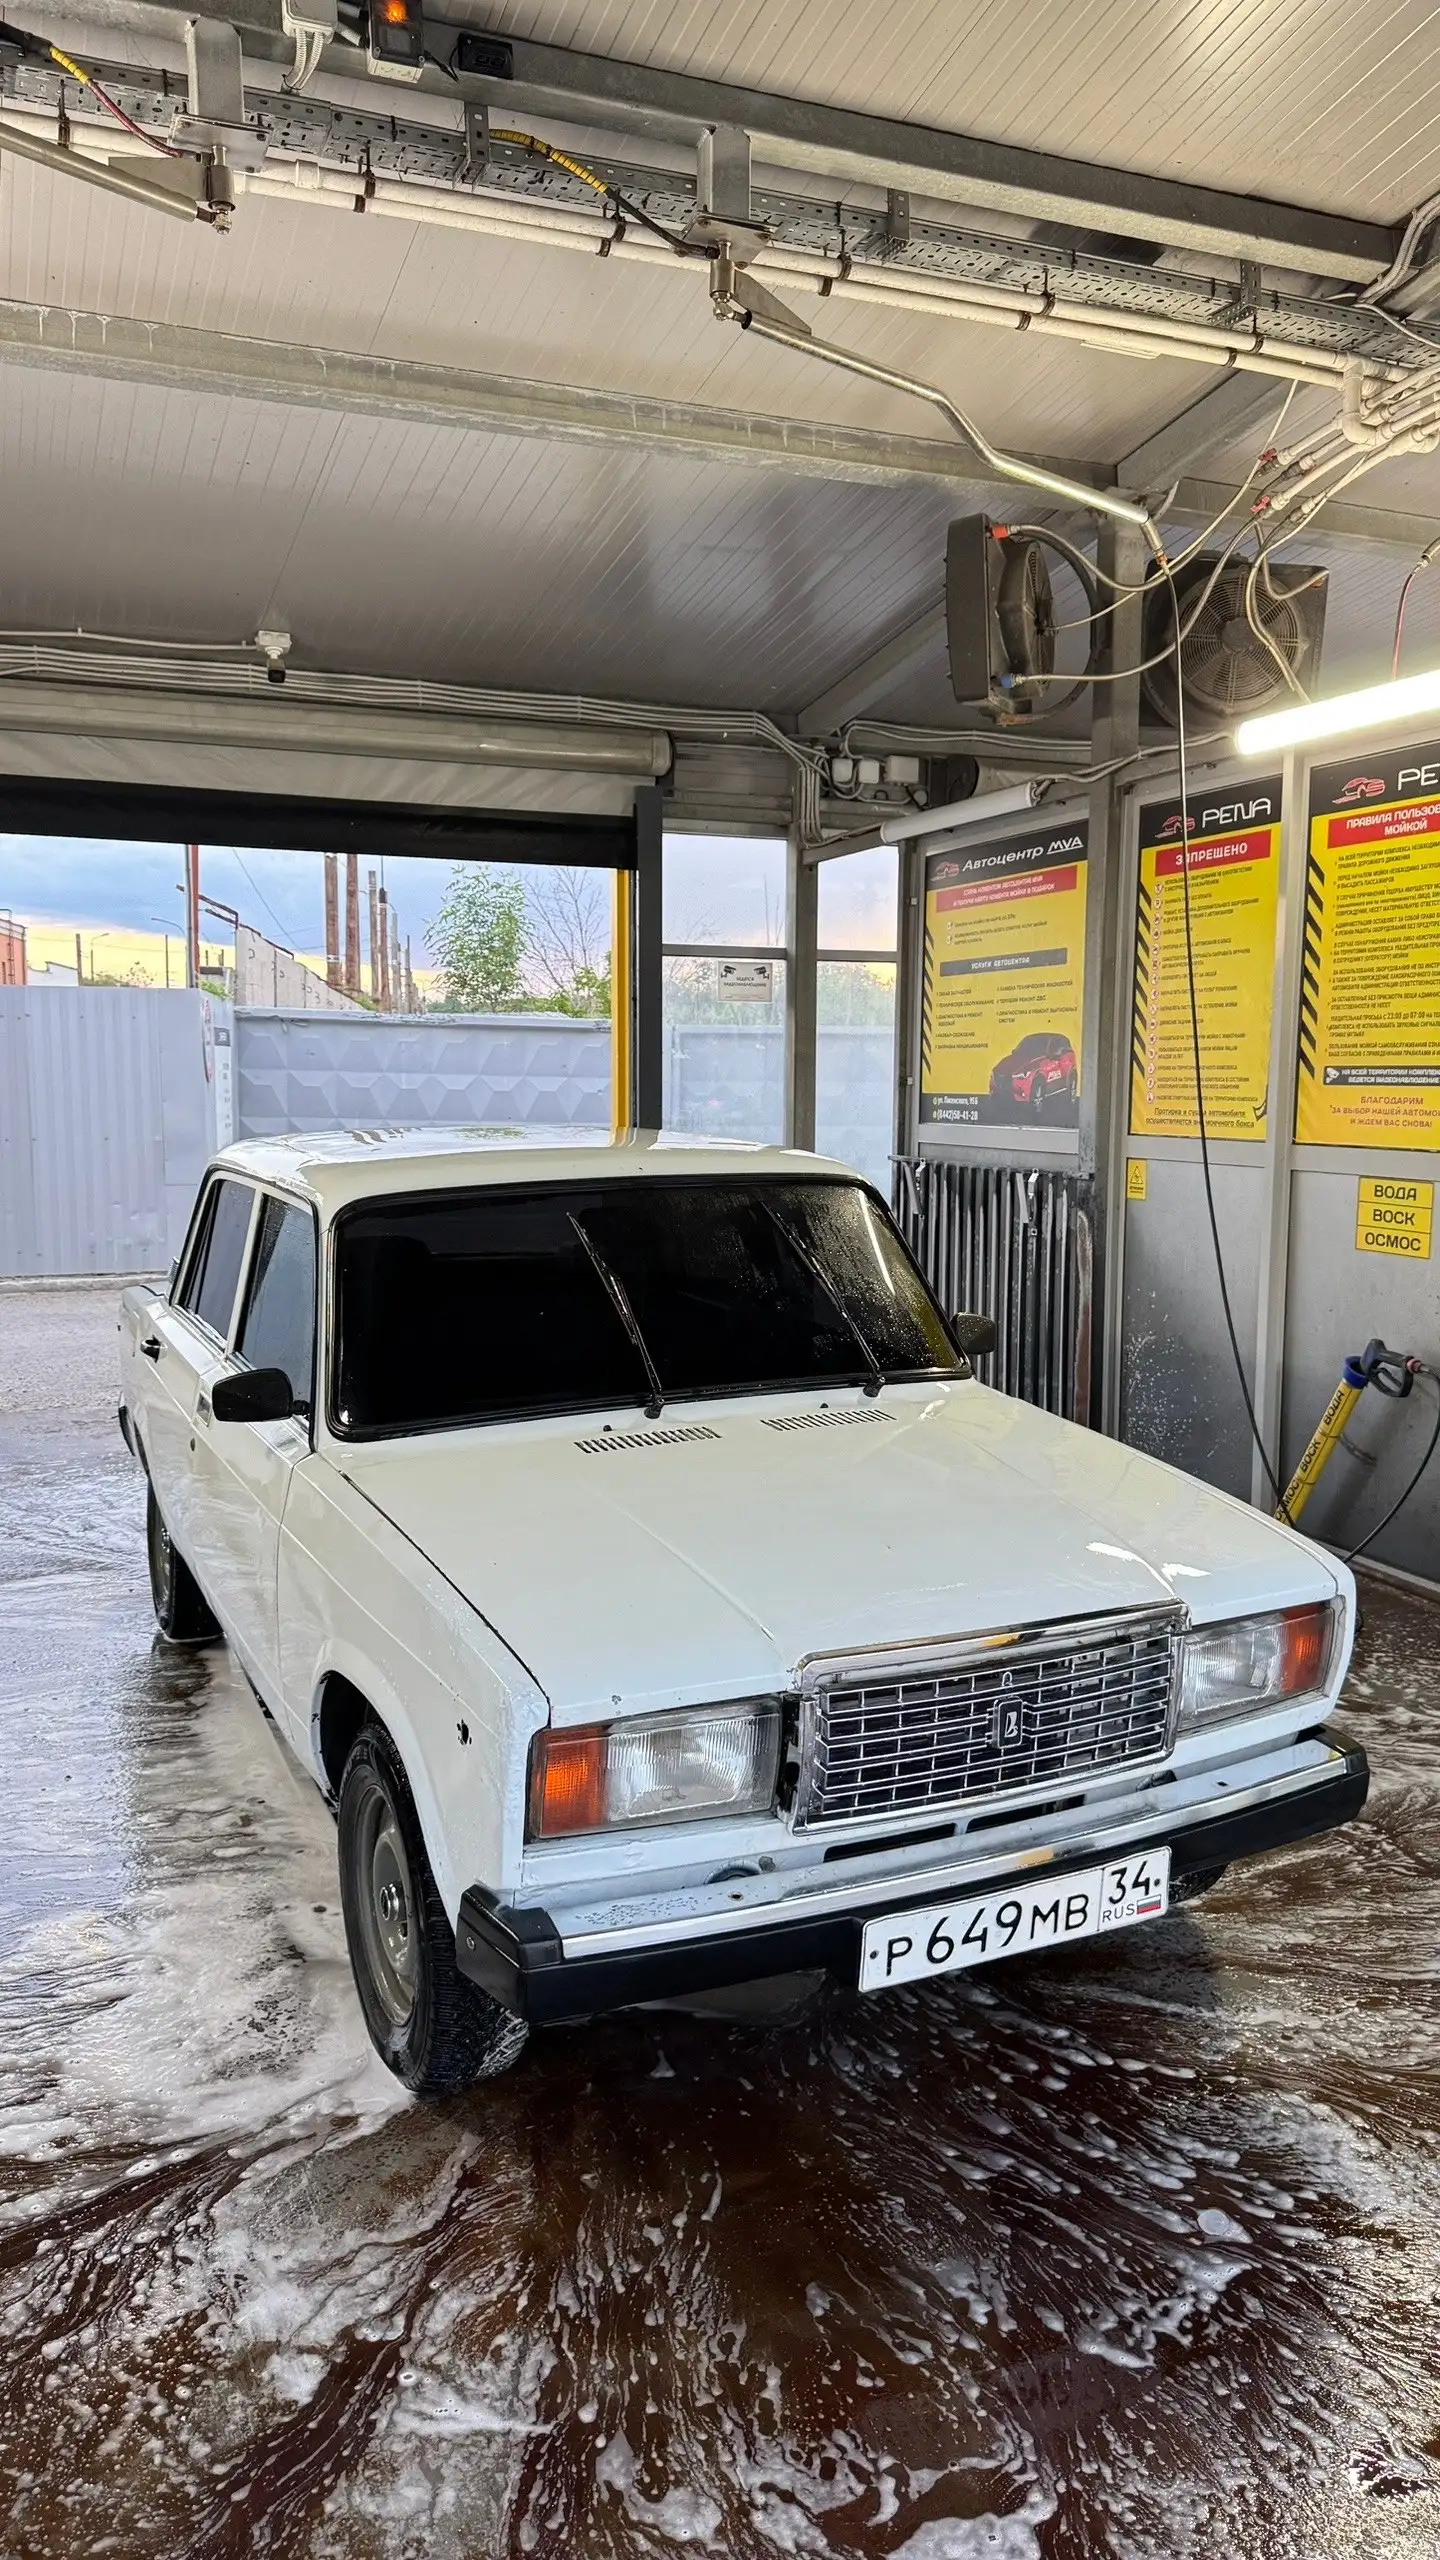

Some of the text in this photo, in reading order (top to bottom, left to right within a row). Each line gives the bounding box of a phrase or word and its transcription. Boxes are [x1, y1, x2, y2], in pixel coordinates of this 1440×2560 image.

[1202, 798, 1271, 828] PENA
[1347, 812, 1392, 829] ПРАВИЛА
[1385, 818, 1427, 835] МОЙКОЙ
[962, 846, 1043, 872] Автоцентр
[1372, 1107, 1400, 1115] НАШЕЙ
[1402, 1120, 1432, 1128] СНОВА!
[1374, 1184, 1417, 1201] ВОДА
[1373, 1209, 1415, 1225] ВОСК
[1365, 1232, 1421, 1251] ОСМОС
[1322, 1389, 1344, 1426] ВОДА
[1300, 1440, 1321, 1473] ВОСК
[1108, 1860, 1151, 1904] 34
[1102, 1904, 1135, 1923] RUS
